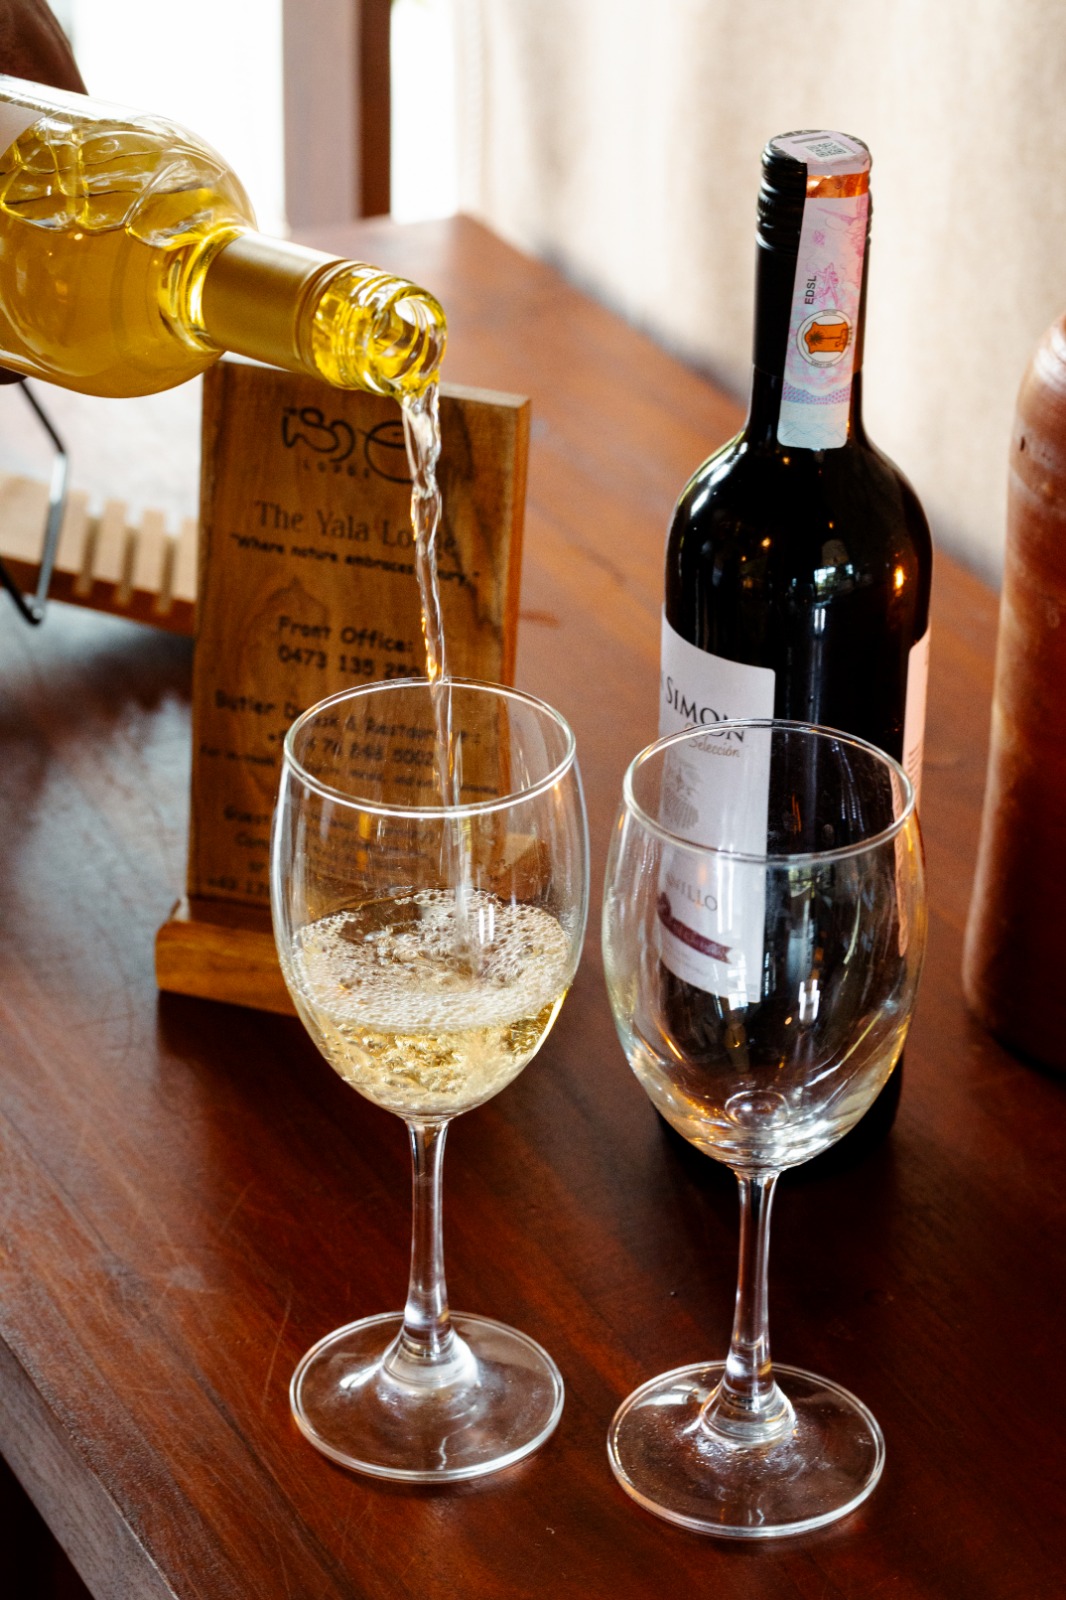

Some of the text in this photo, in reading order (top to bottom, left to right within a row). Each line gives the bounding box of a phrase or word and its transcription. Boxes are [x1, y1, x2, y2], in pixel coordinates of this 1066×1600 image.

[804, 275, 817, 305] EDSL
[254, 500, 457, 560] The Yala Loe
[277, 614, 414, 654] Front Office:
[666, 676, 745, 743] SIMON
